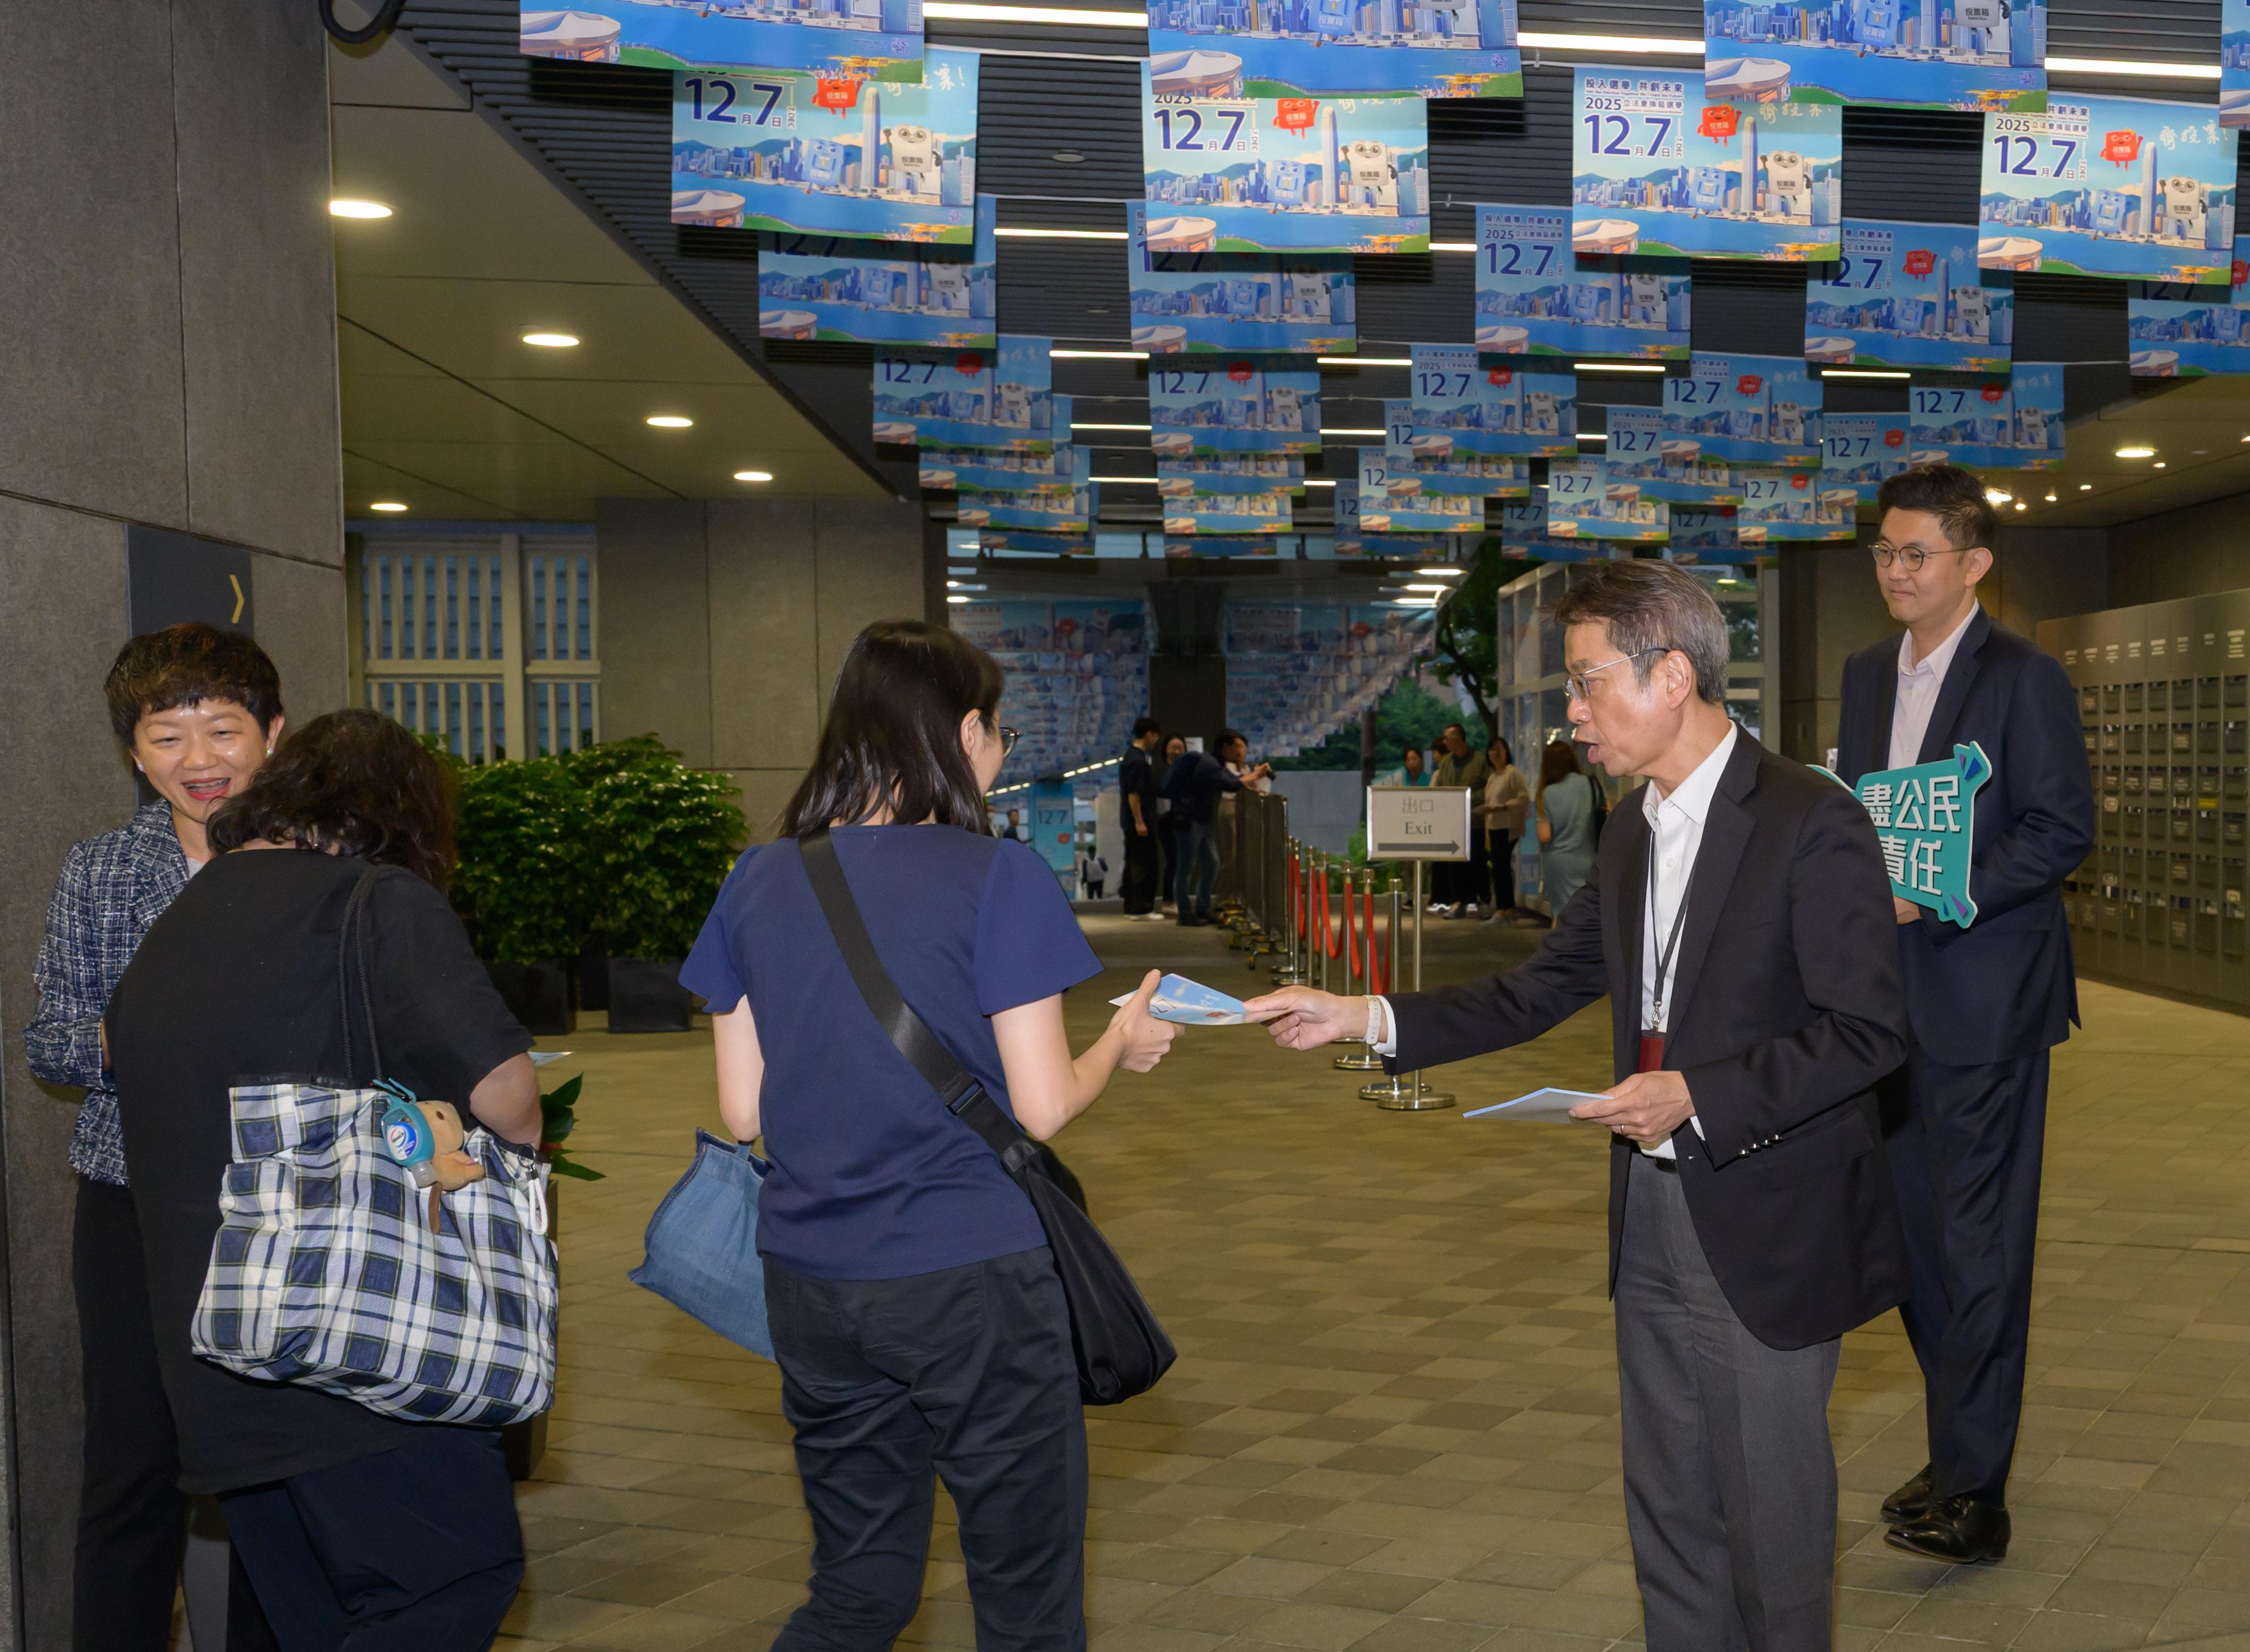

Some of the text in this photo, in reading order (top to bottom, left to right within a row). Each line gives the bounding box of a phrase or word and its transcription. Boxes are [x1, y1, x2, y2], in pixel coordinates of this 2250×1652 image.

[1965, 8, 1989, 17] 投票箱
[1586, 78, 1683, 93] 投入選舉 共創未來
[1585, 97, 1621, 110] 2025
[2047, 105, 2088, 116] 共創未來
[1153, 109, 1245, 151] 12月7日
[1996, 118, 2030, 132] 2025
[1584, 114, 1671, 157] 12月7日
[1994, 135, 2076, 179] 12月7日
[1485, 228, 1514, 240] 2025
[1403, 797, 1434, 814] 出口
[1862, 775, 1961, 832] 盡公民
[1405, 821, 1433, 835] Exit
[1879, 835, 1942, 896] 責任
